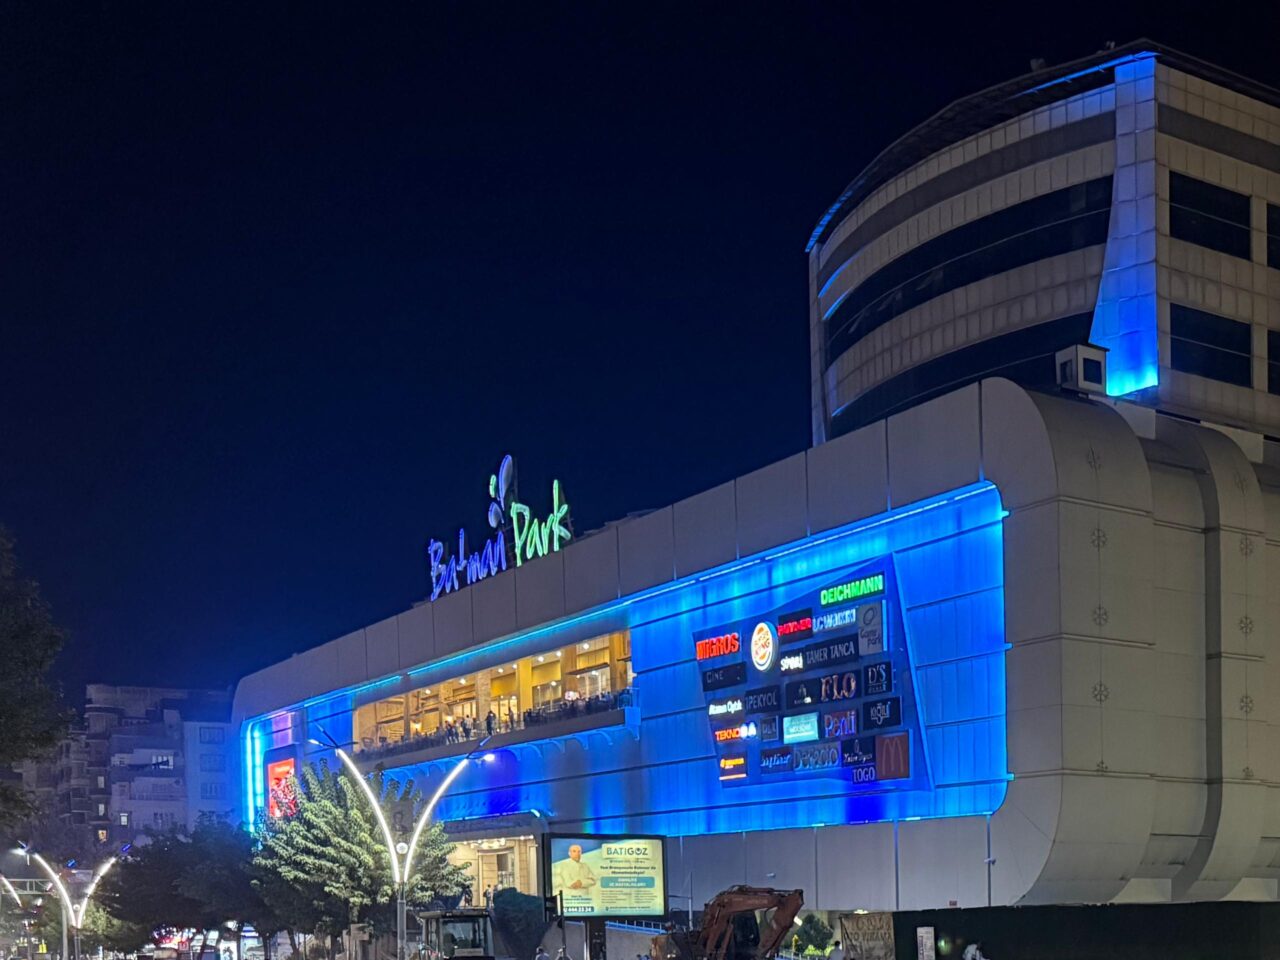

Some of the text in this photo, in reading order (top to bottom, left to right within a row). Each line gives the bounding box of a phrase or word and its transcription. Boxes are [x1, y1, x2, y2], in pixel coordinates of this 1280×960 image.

[429, 479, 572, 602] Batman Park
[820, 574, 883, 606] DEICHMANN
[829, 641, 855, 660] TANCA
[820, 672, 857, 702] FLO
[823, 709, 857, 738] Penti
